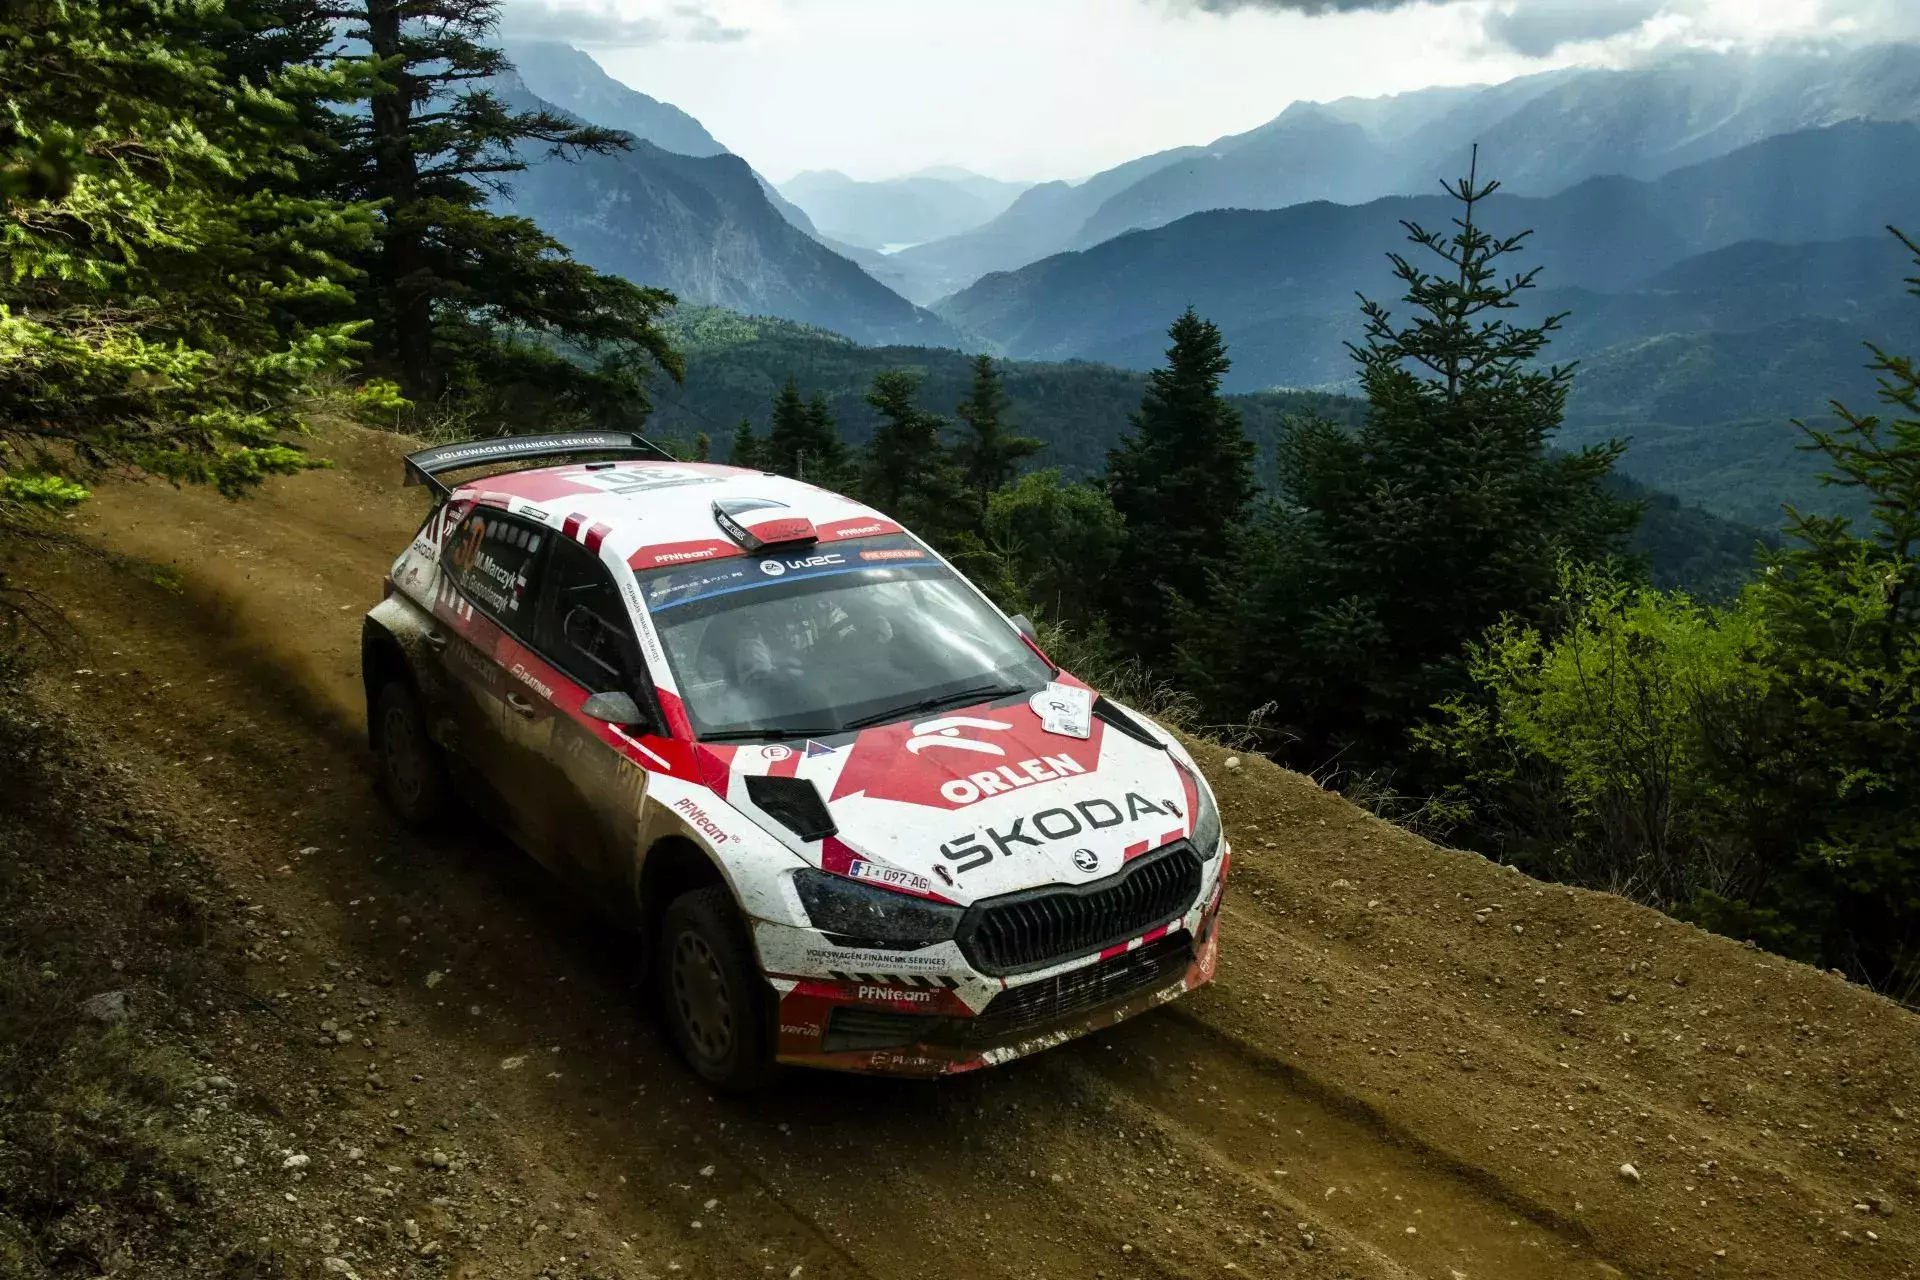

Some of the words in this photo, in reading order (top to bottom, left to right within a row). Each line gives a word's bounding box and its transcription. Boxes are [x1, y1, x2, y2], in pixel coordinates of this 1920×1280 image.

[435, 445, 506, 460] VOLKSWAGEN
[508, 440, 560, 450] FINANCIAL
[561, 437, 605, 446] SERVICES
[655, 550, 713, 563] PFNteam
[785, 554, 846, 569] WRC
[520, 672, 554, 700] PLATINUM
[770, 748, 781, 757] E
[940, 753, 1086, 804] ORLEN
[674, 797, 728, 844] PFNteam
[883, 870, 928, 890] 097-AG
[806, 949, 862, 960] VOLKSWAGEN
[908, 957, 946, 965] SERVICES
[858, 985, 931, 1002] PFNteam
